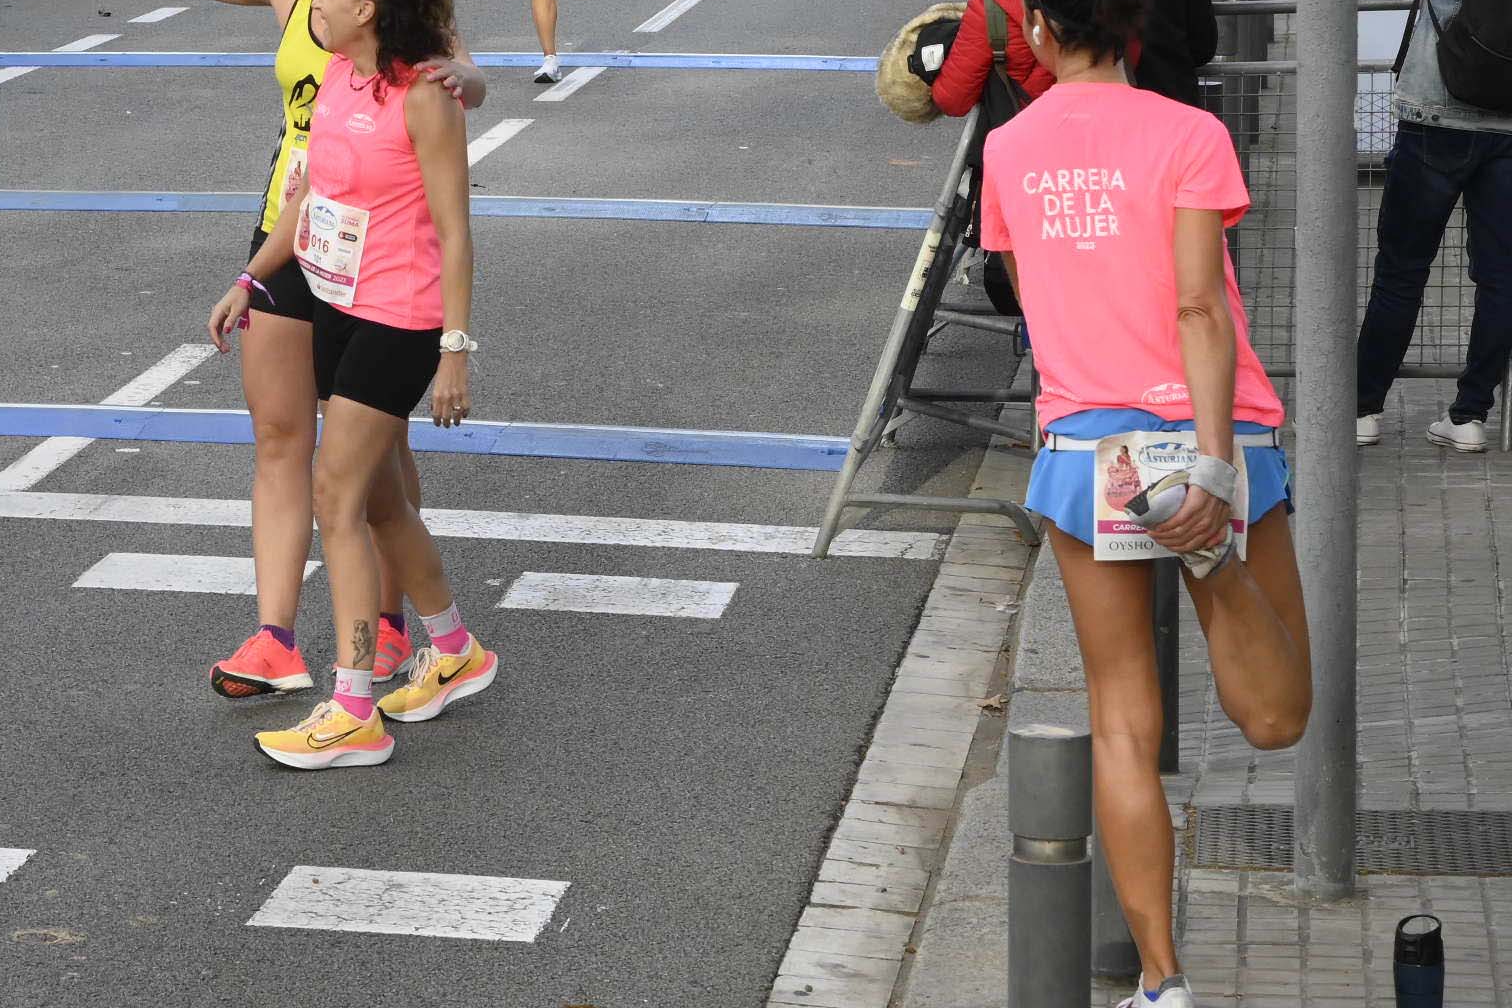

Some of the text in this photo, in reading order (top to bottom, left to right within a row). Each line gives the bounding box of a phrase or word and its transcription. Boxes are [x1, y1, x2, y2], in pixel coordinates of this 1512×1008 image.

[1023, 168, 1127, 194] CARRERA
[1043, 190, 1114, 216] DE LA
[1041, 215, 1120, 241] MUJER
[311, 234, 330, 253] 016
[1109, 541, 1154, 552] OYSHO
